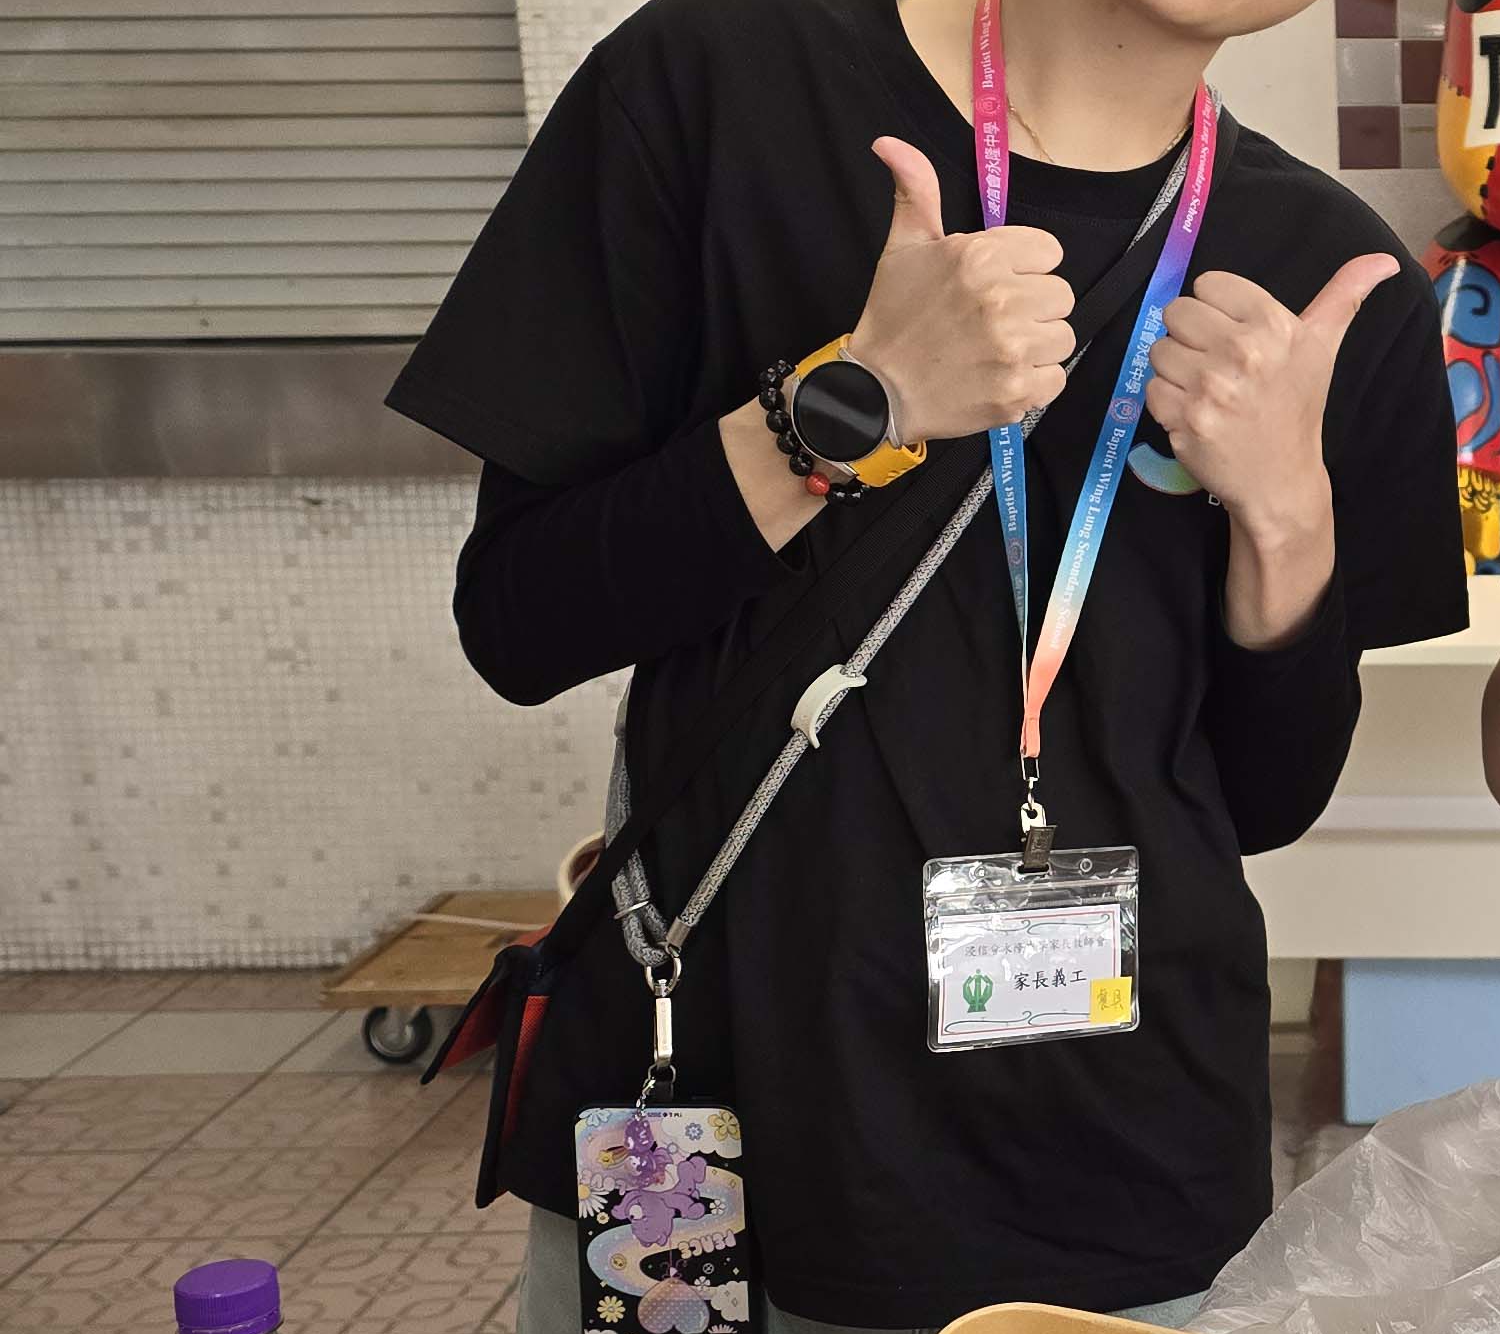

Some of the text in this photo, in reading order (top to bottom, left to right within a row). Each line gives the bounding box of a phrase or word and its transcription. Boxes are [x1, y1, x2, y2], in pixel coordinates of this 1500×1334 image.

[982, 51, 996, 89] Baptist
[984, 122, 1002, 218] 浸信會永隆中學
[1193, 144, 1209, 196] Secondary
[1182, 195, 1200, 234] School
[1103, 427, 1126, 469] Baptist
[998, 426, 1018, 531] Baptist Wing Lu
[1089, 472, 1113, 504] Wing
[1078, 504, 1100, 539] Lung
[1060, 542, 1090, 605] Secondary
[1014, 967, 1087, 991] 家長義工
[678, 1230, 736, 1259] PEACE
